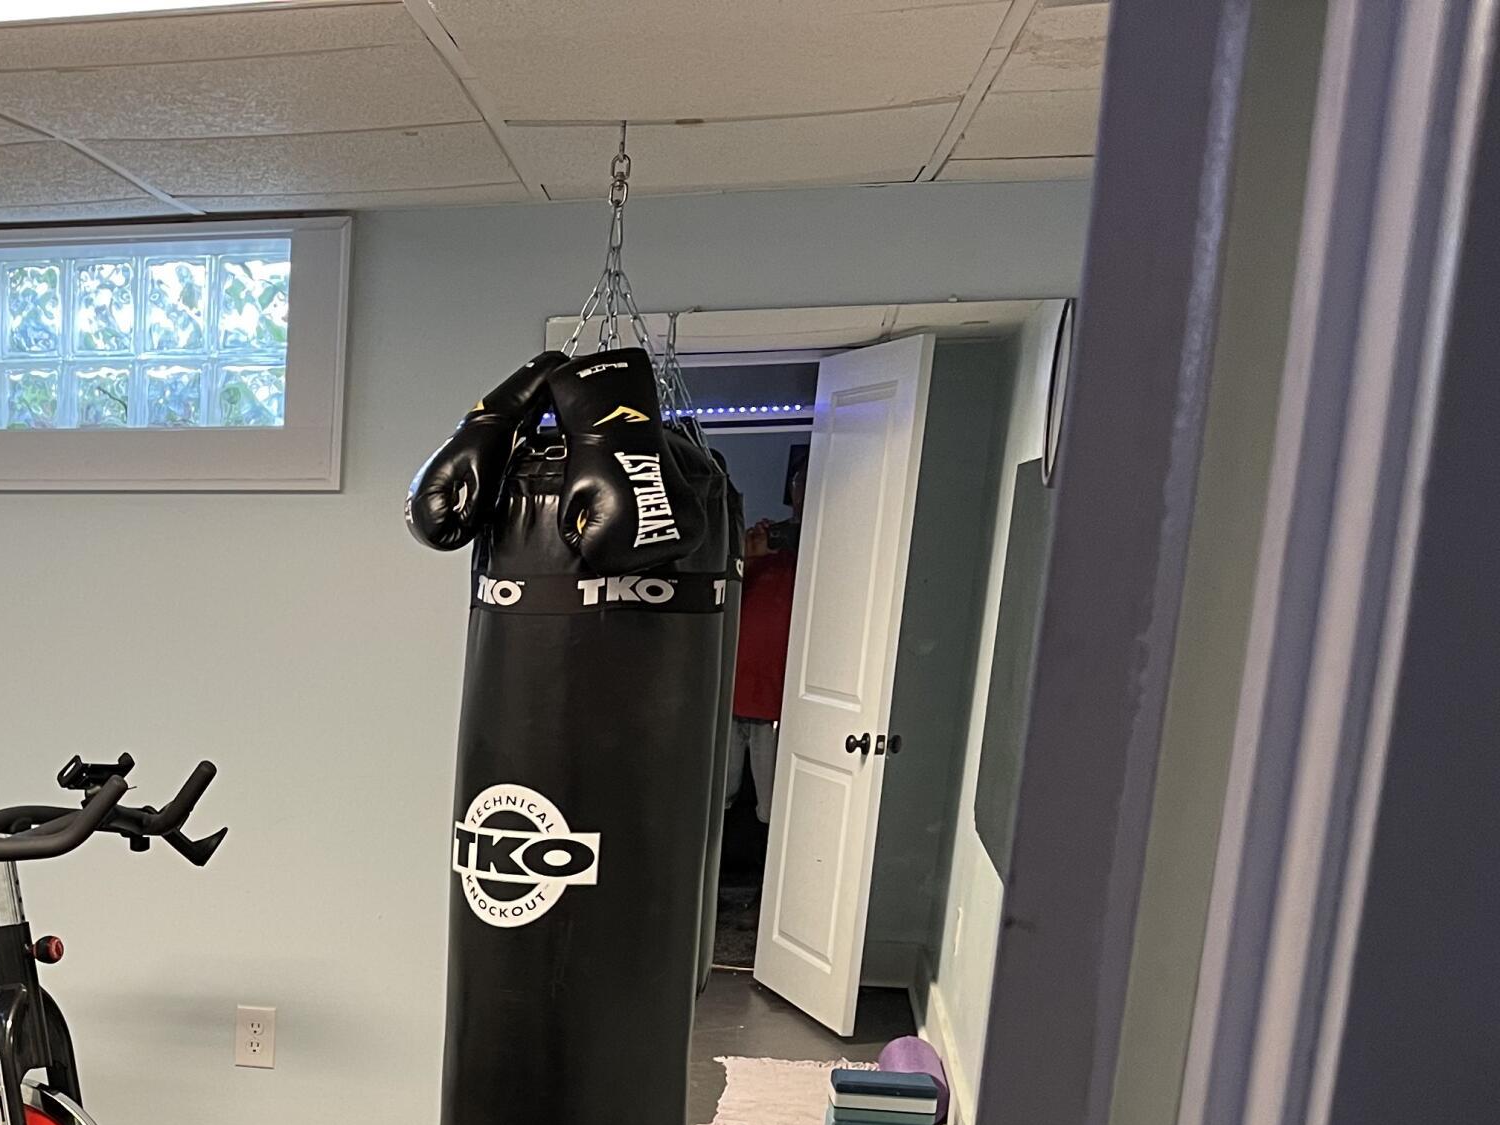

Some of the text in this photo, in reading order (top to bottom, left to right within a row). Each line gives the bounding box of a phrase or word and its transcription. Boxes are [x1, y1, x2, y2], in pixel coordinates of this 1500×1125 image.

[614, 451, 681, 548] EVERLAST
[577, 575, 675, 606] TKO
[470, 795, 555, 834] TECHNICAL
[455, 827, 595, 878] TKO
[466, 874, 546, 918] KNOCKOUT
